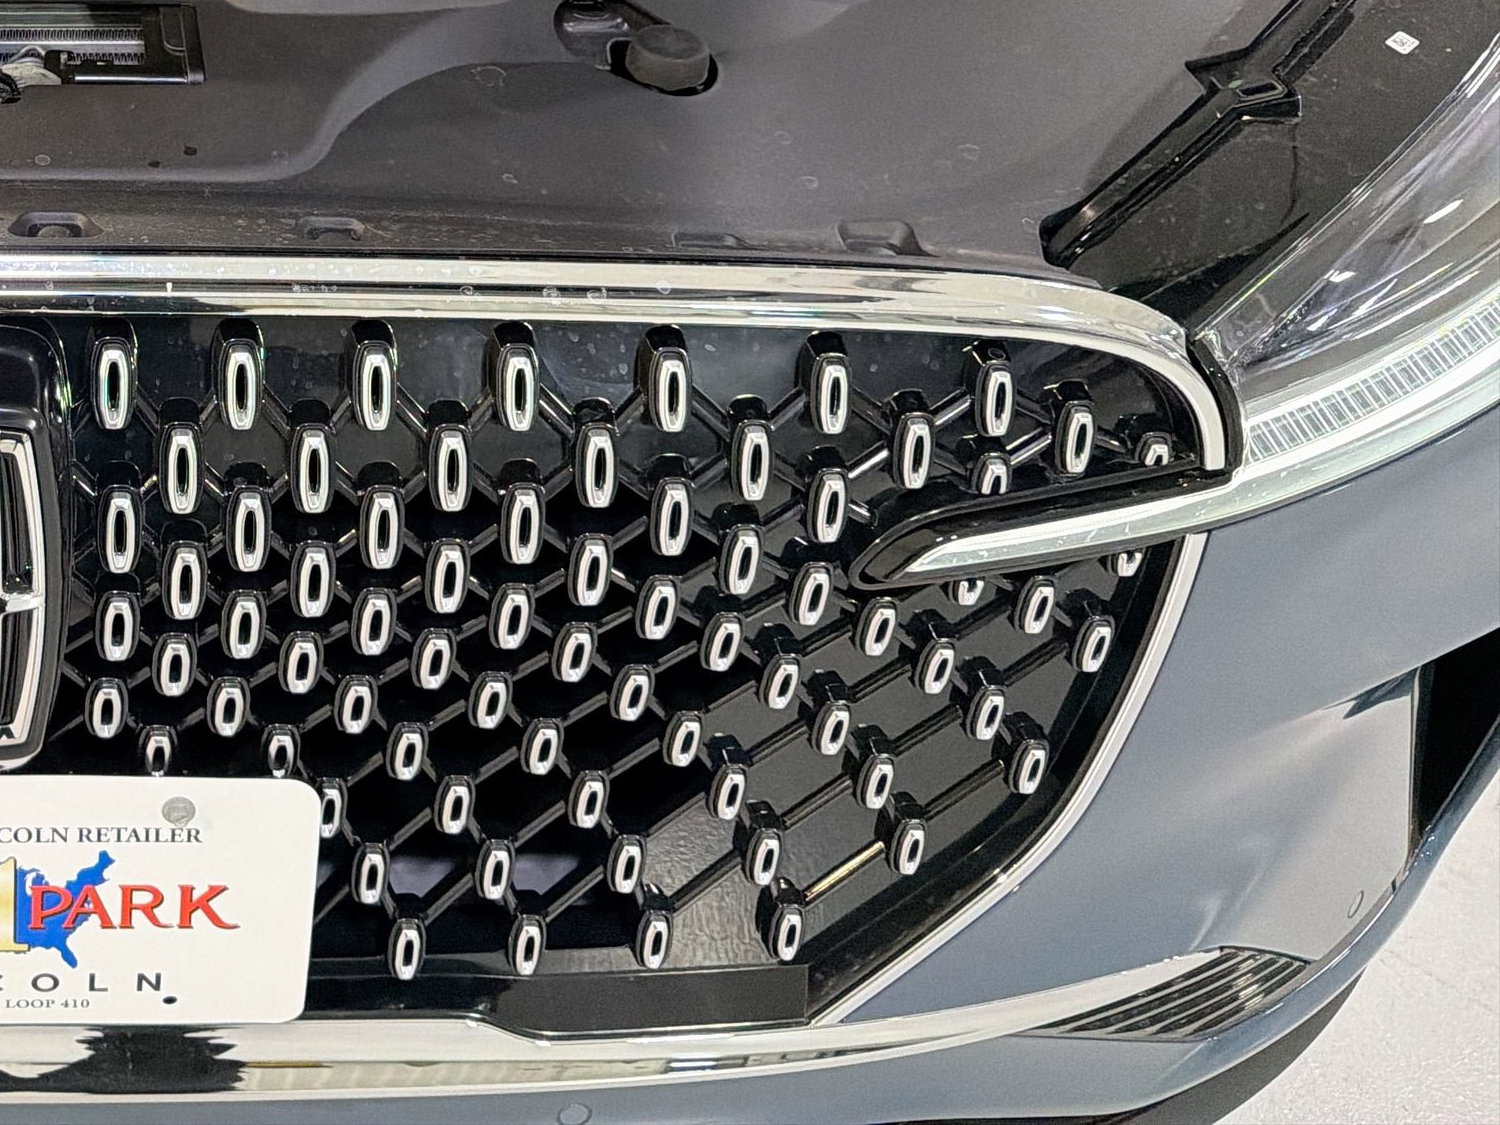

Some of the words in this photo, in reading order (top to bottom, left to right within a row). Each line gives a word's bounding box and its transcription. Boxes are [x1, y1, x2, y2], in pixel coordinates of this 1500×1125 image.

[77, 826, 203, 844] RETAILER
[29, 884, 241, 930] PARK
[5, 999, 55, 1009] LOOP
[60, 999, 90, 1009] 410
